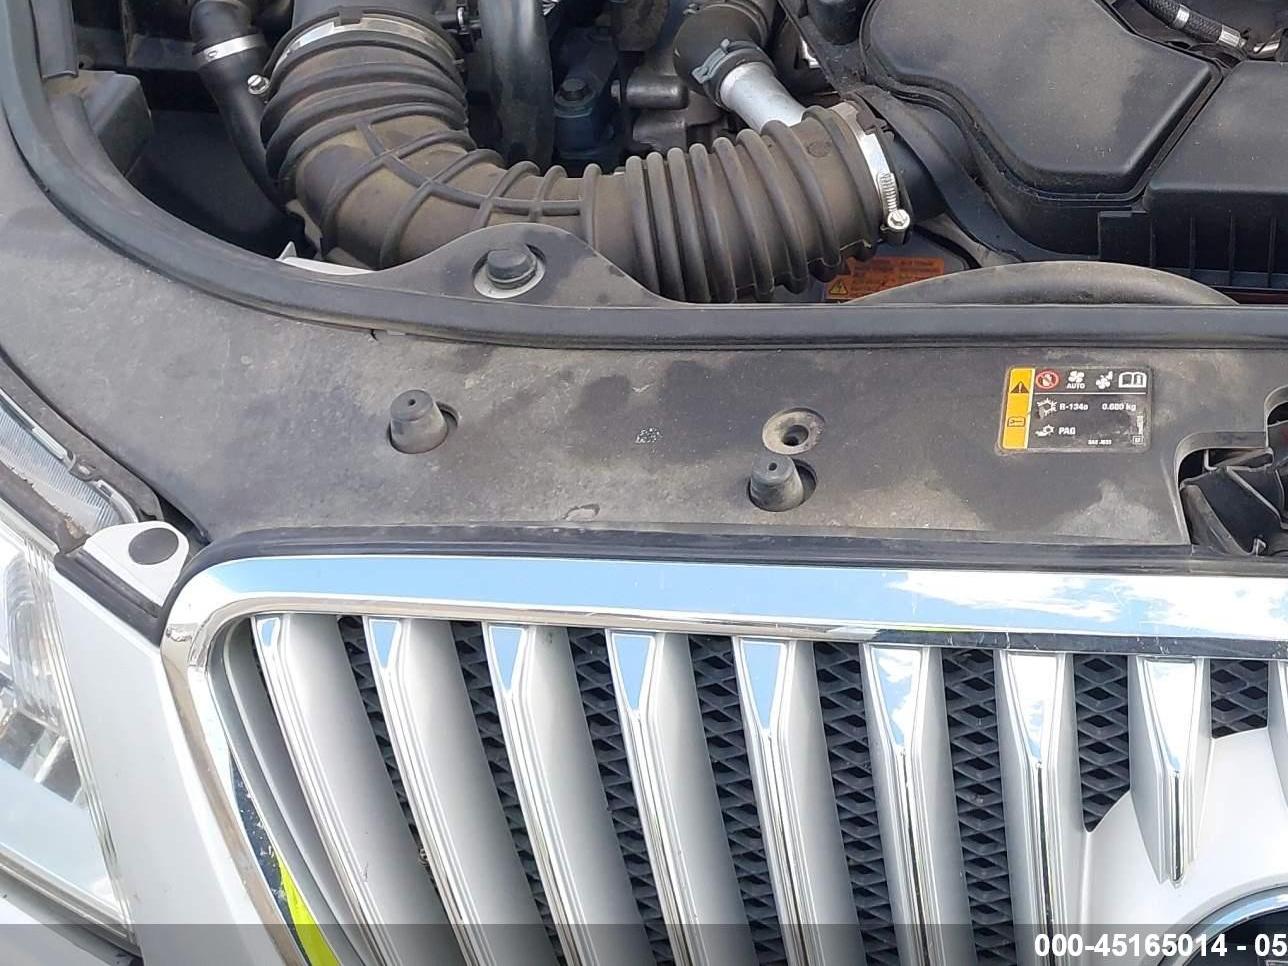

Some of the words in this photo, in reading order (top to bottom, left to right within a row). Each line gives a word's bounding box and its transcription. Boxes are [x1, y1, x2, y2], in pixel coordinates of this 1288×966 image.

[1059, 403, 1089, 411] R-134a
[1125, 403, 1137, 412] kg
[1058, 427, 1076, 435] PAG
